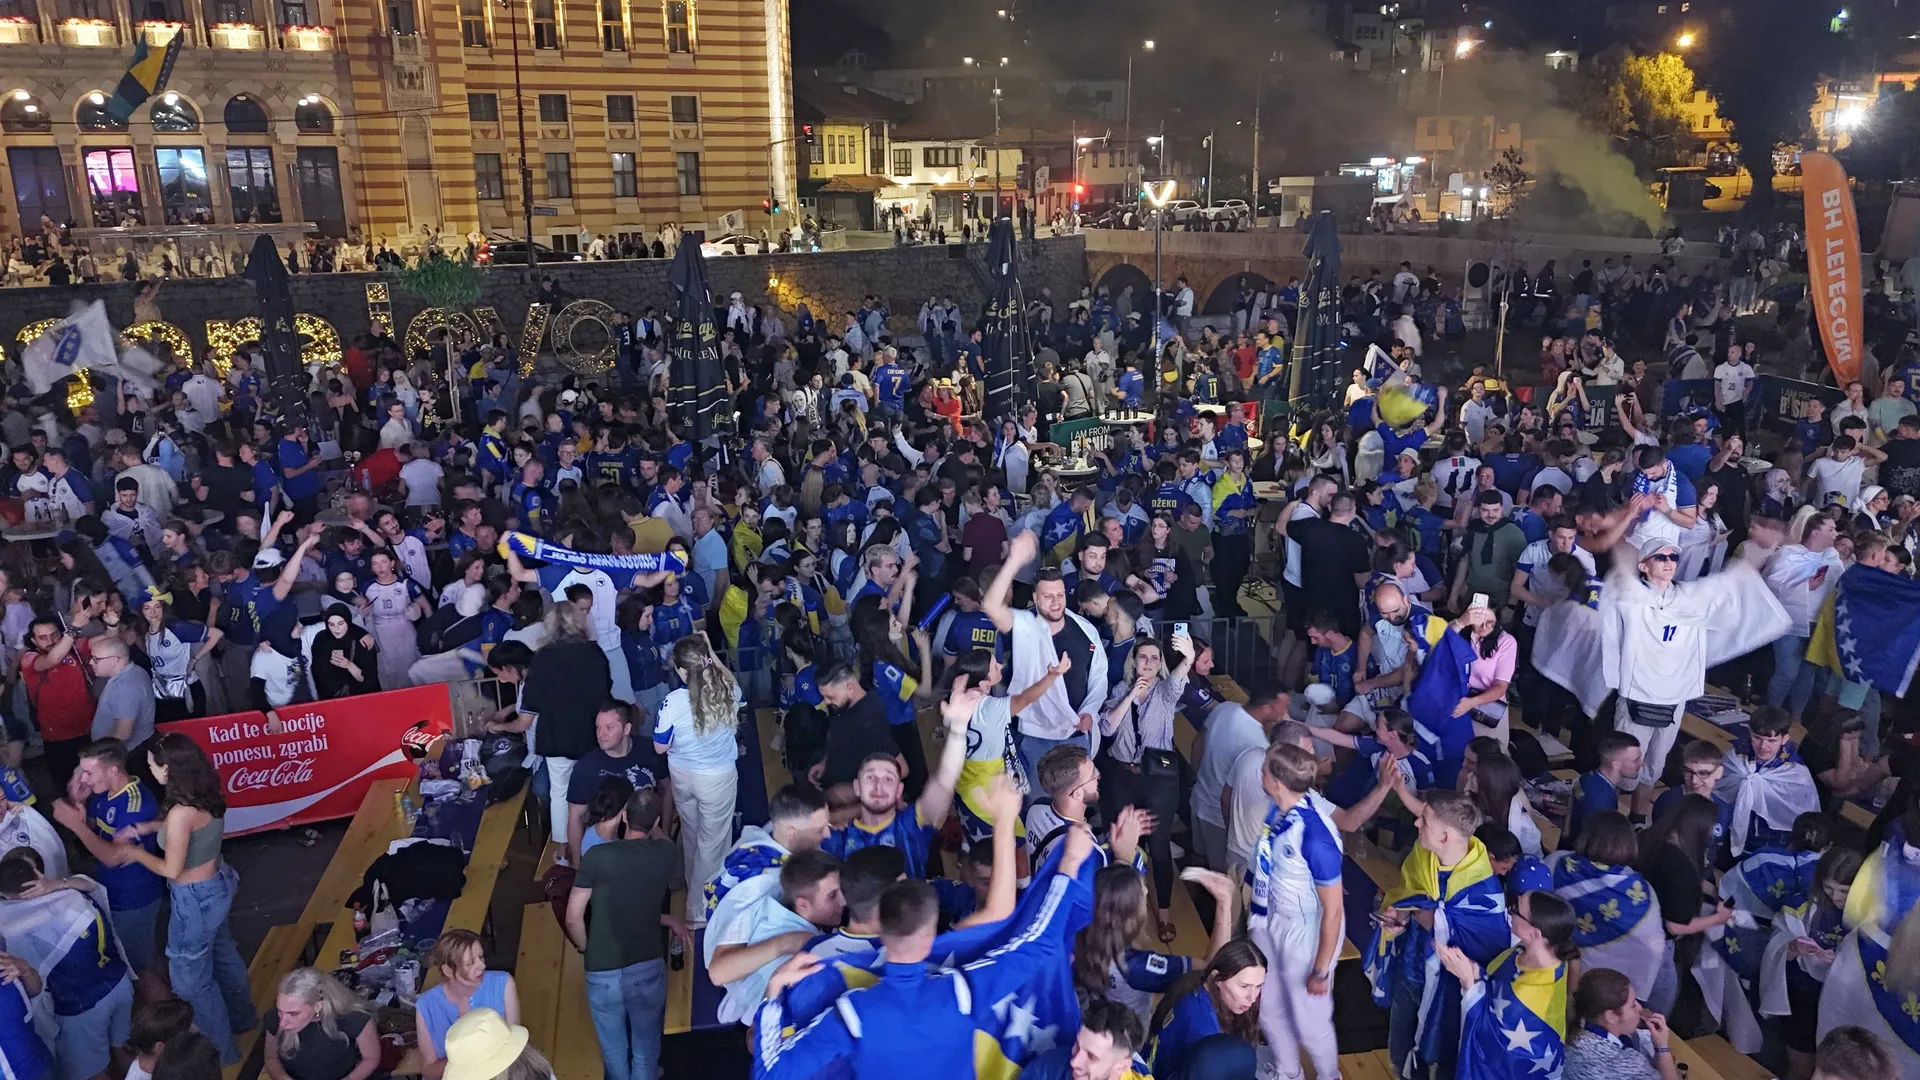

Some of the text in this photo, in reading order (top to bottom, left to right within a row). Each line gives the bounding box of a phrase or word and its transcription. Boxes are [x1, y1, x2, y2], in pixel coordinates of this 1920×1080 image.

[891, 376, 902, 395] 7
[1074, 430, 1087, 439] AM
[1088, 425, 1111, 437] FROM
[1151, 497, 1177, 508] DŽEKO
[208, 722, 240, 743] Kad
[243, 722, 260, 739] te
[212, 735, 328, 769] ponesu, zgrabi
[227, 757, 317, 793] Coca-Cola
